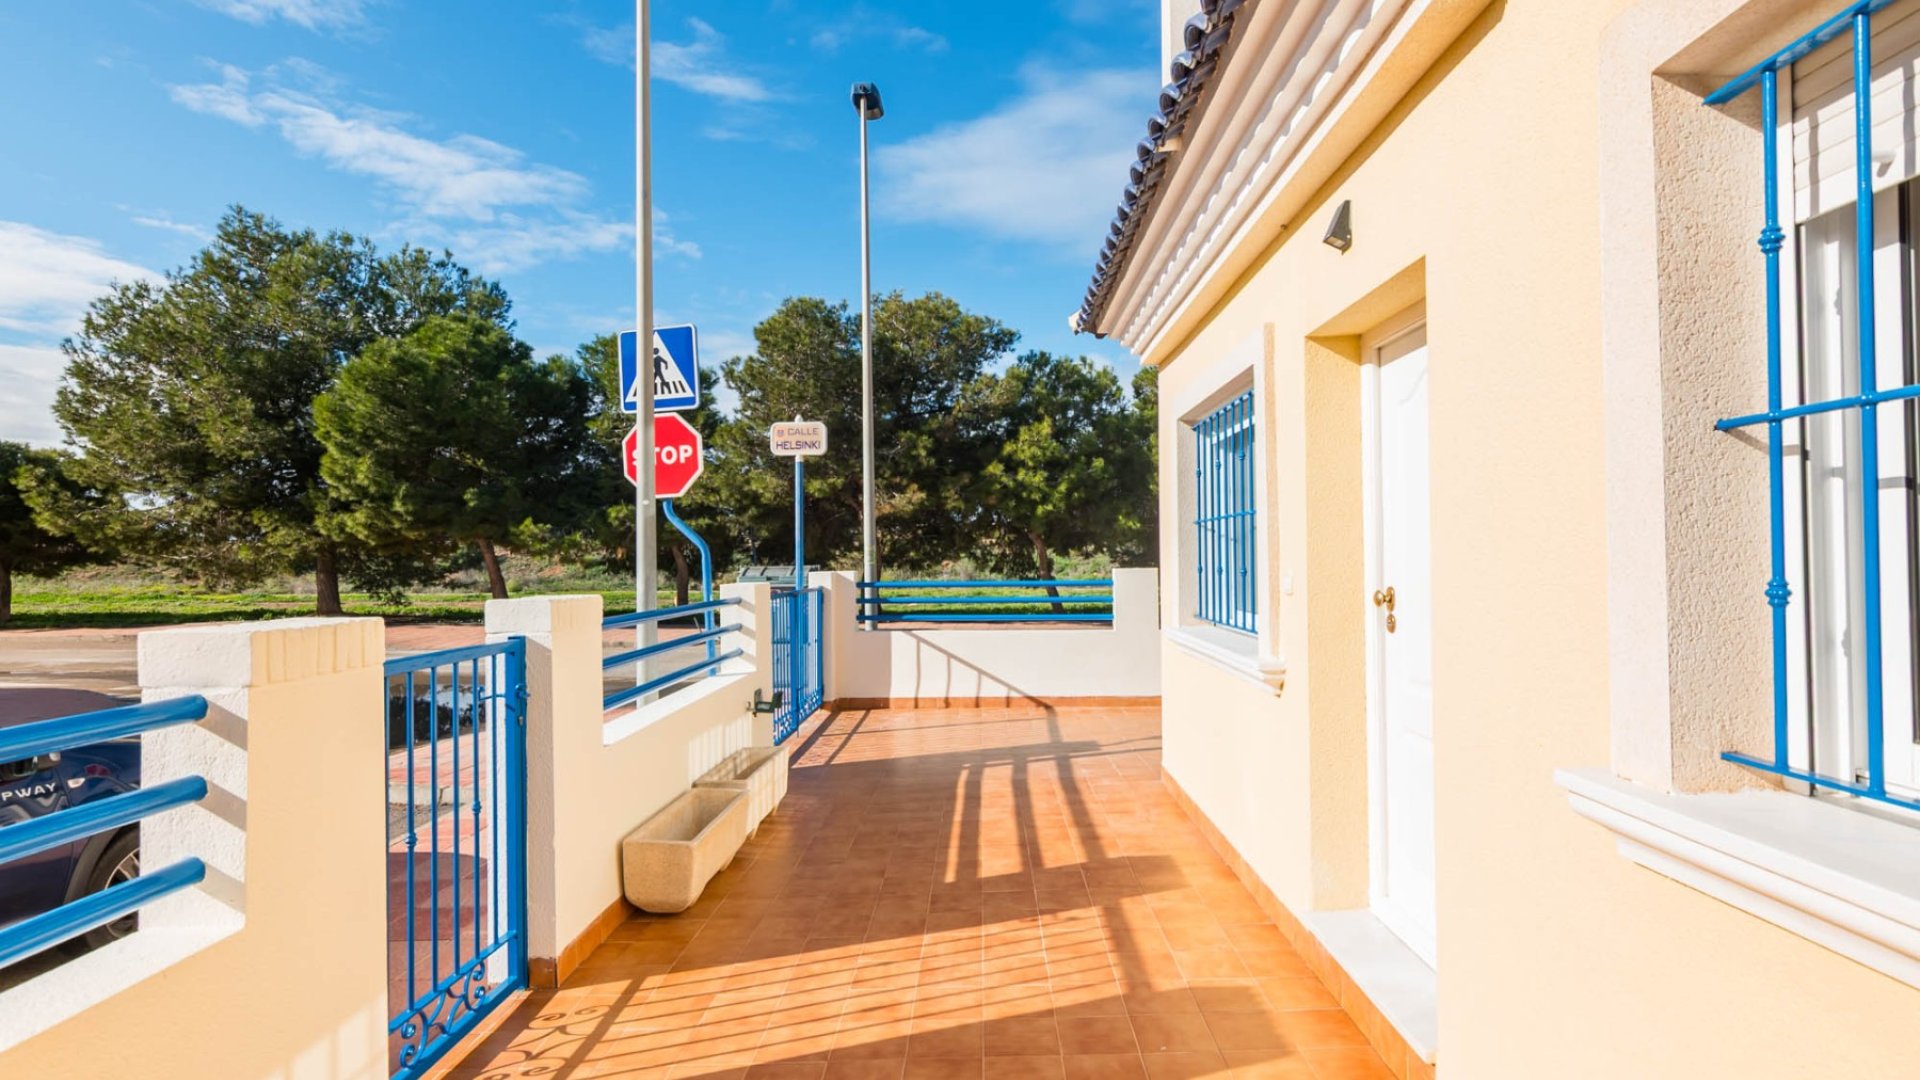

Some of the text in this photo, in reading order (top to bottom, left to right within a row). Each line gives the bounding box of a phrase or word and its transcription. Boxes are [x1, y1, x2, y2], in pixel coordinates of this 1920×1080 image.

[787, 427, 819, 436] CALLE
[776, 440, 821, 450] HELSINKI
[1, 782, 56, 801] PWAY
